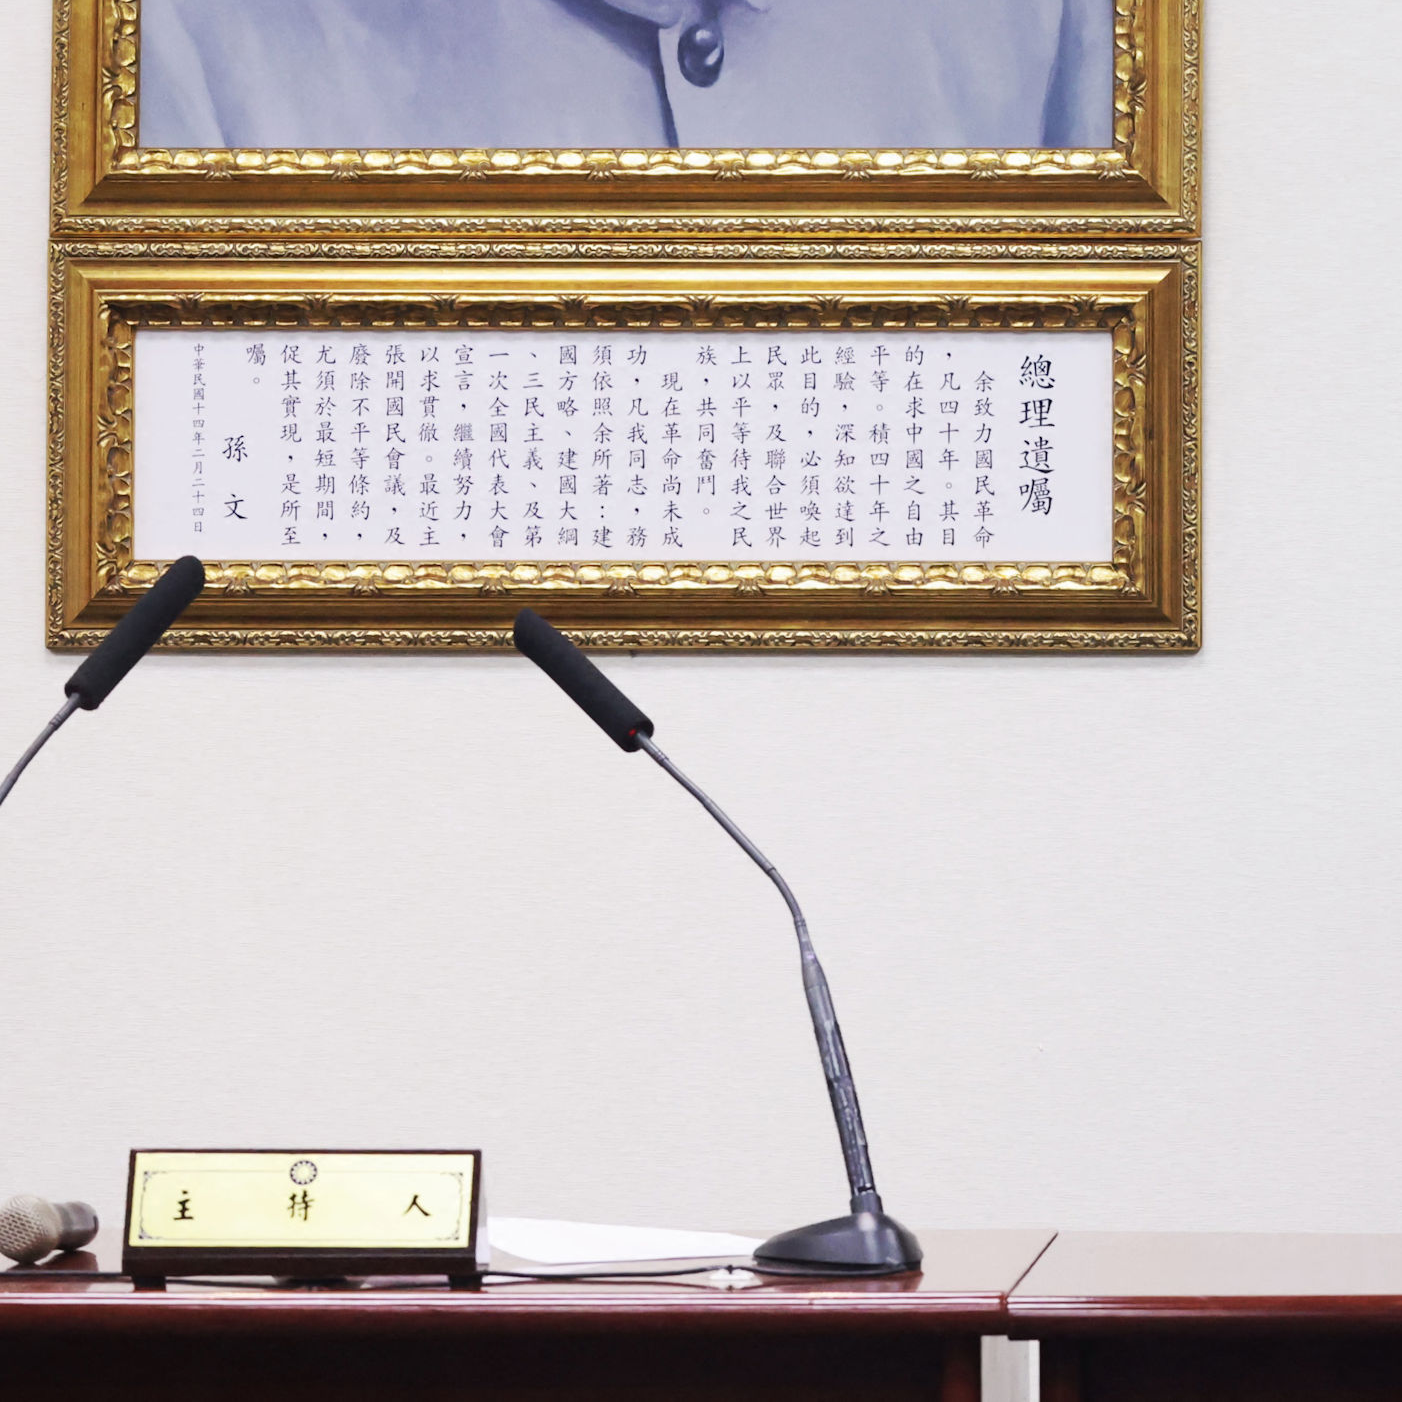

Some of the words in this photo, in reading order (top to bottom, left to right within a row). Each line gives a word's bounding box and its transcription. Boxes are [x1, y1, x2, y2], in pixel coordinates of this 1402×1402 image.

[191, 342, 206, 533] 中華民國十四年二月二十四日
[1016, 353, 1056, 516] 總理遺囑
